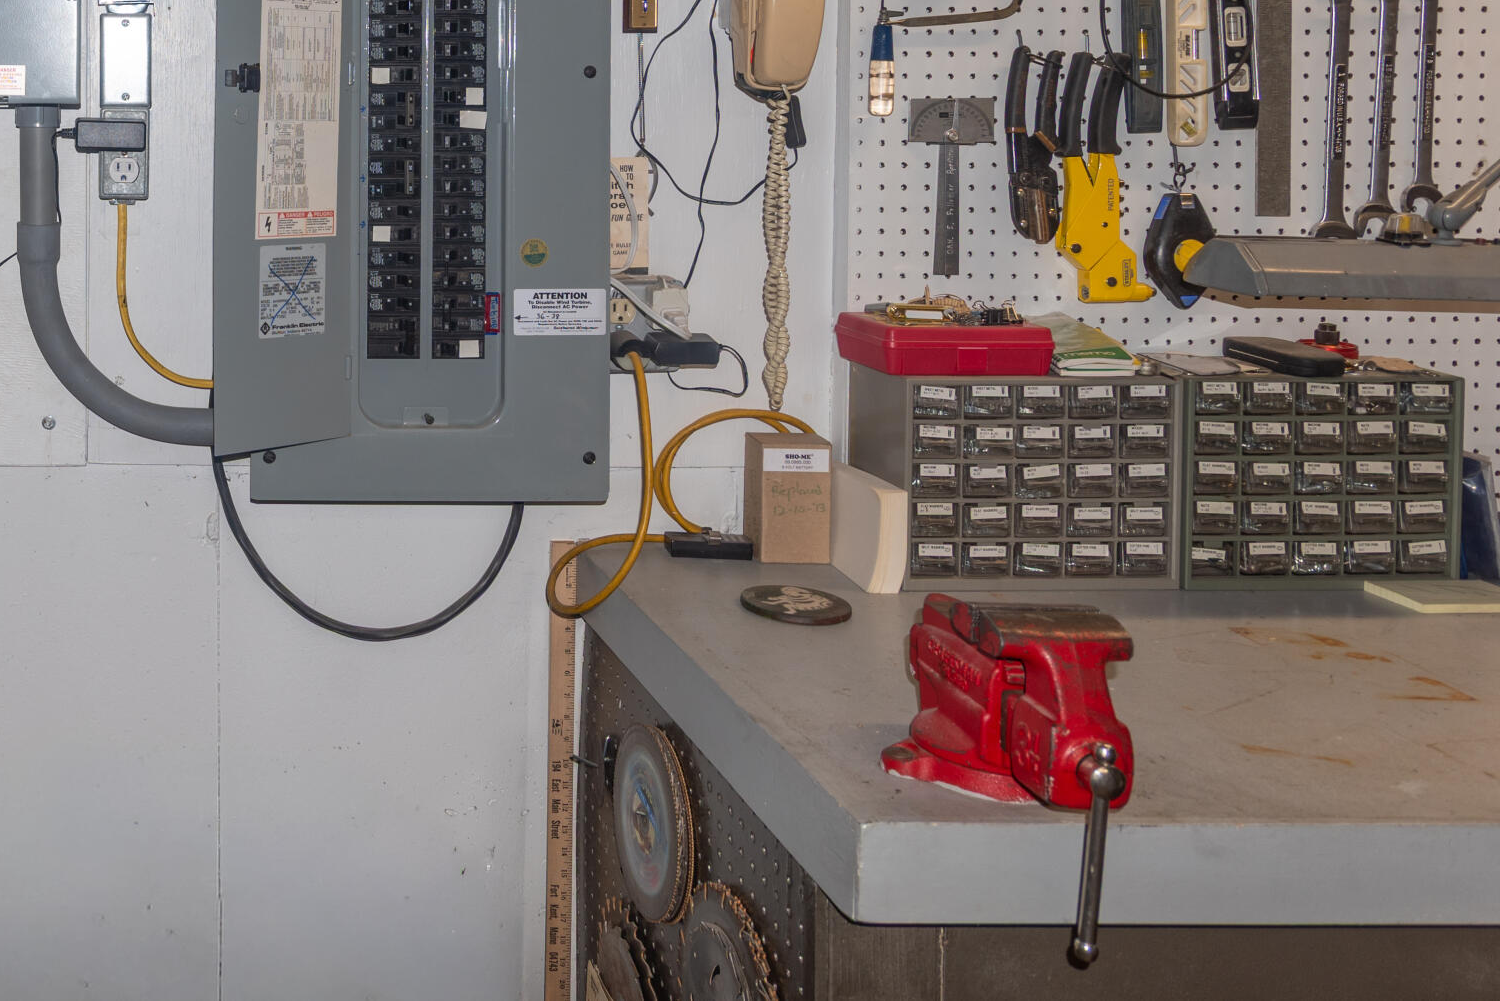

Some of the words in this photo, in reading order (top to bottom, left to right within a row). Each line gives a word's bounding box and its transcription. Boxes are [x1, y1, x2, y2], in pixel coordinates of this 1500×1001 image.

[619, 165, 634, 173] HOW
[626, 173, 634, 181] TO
[1107, 178, 1115, 211] PATENTED
[611, 214, 624, 222] FUN
[532, 292, 588, 300] ATTENTION
[551, 760, 562, 773] 194
[551, 778, 562, 793] East
[551, 799, 561, 814] Main
[550, 819, 561, 840] Street
[550, 884, 560, 898] Fort
[549, 926, 559, 945] Maine
[548, 951, 559, 973] 04743
